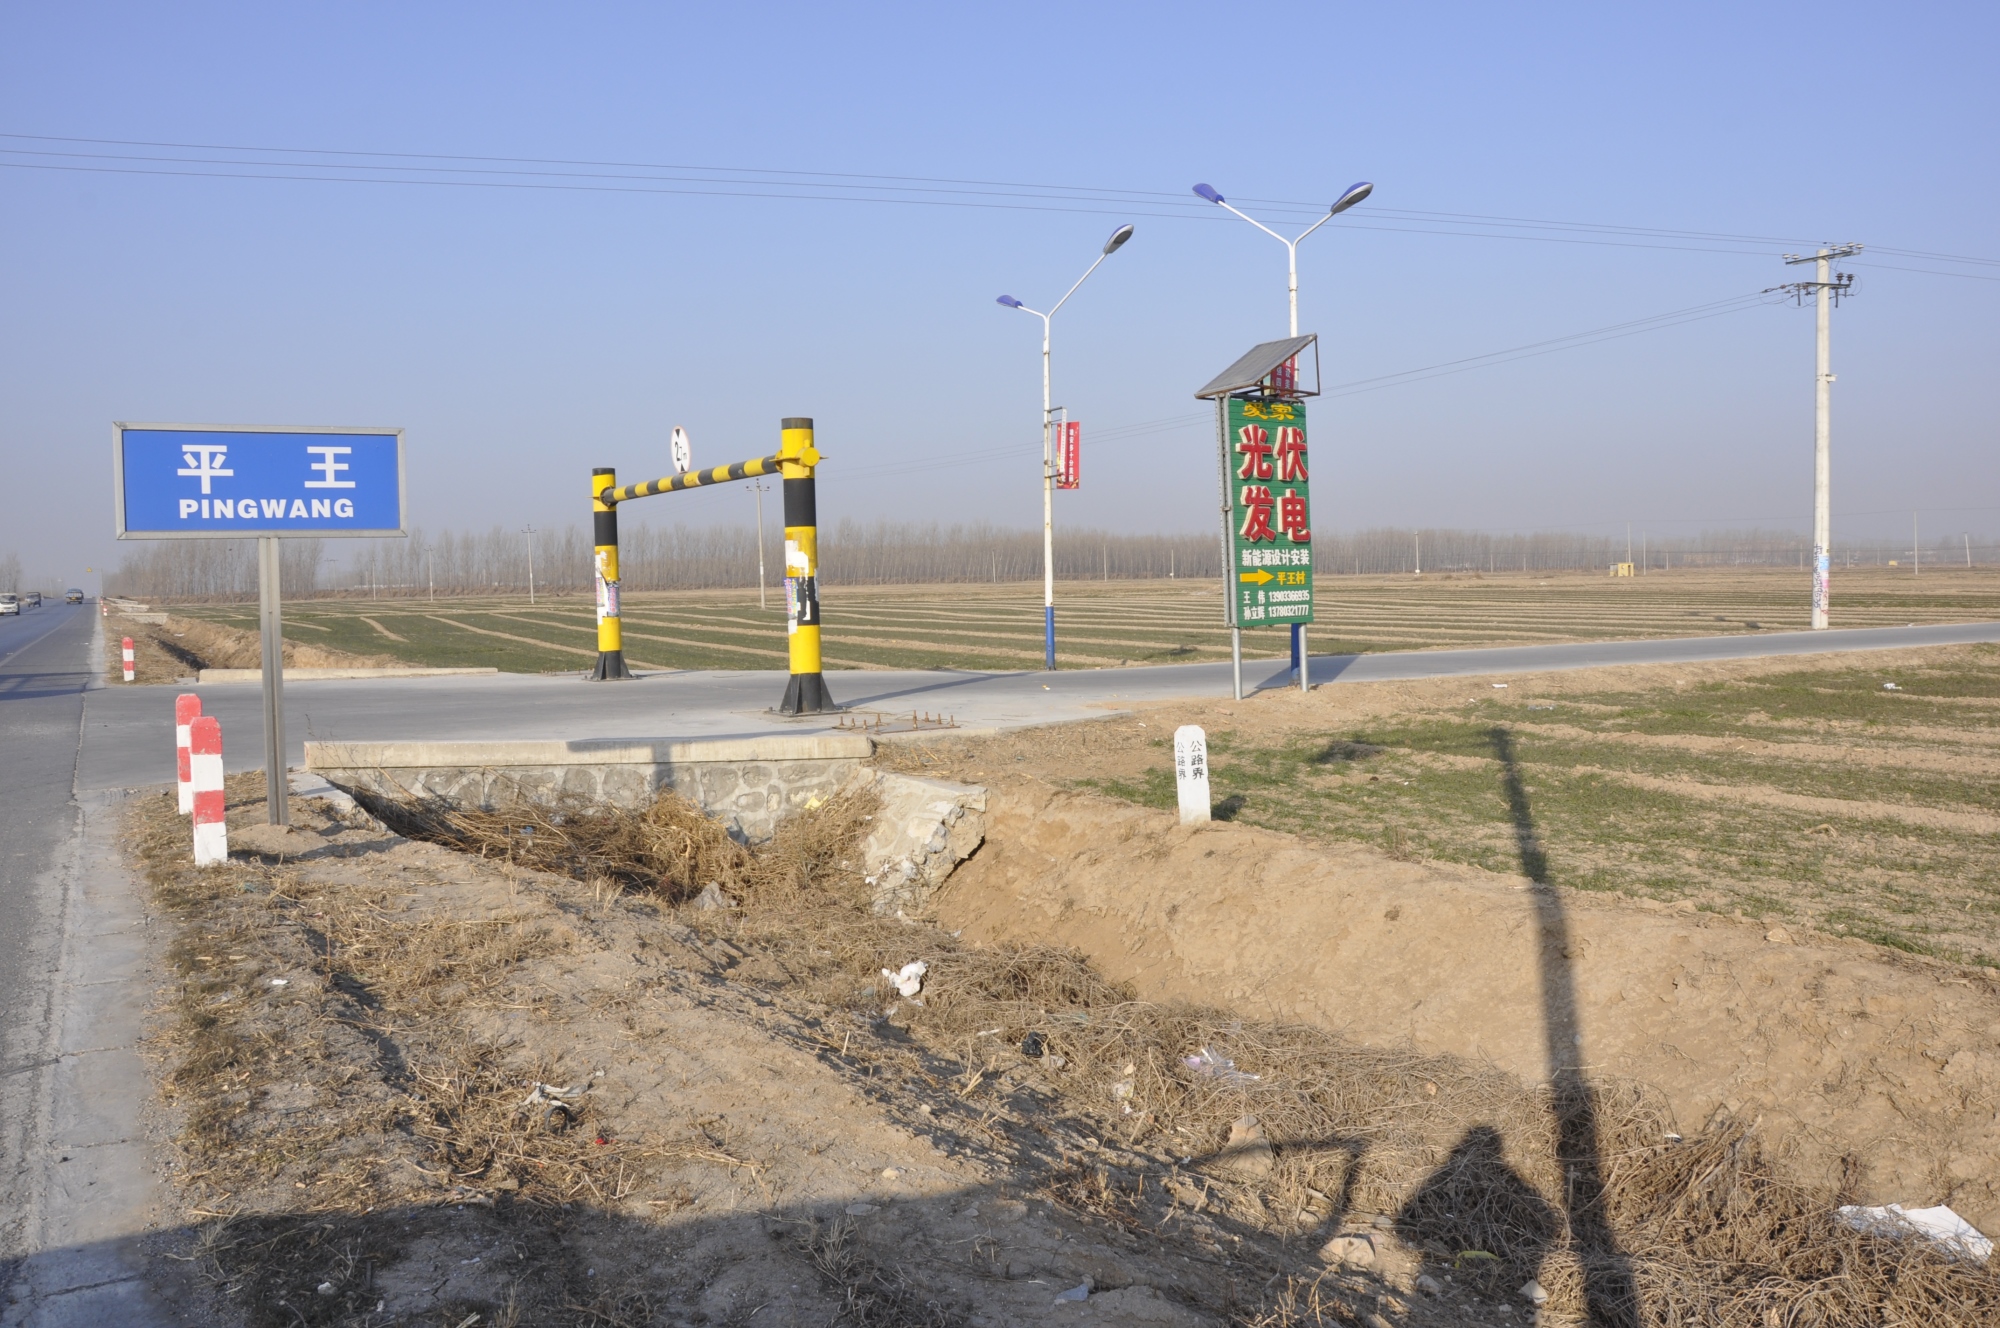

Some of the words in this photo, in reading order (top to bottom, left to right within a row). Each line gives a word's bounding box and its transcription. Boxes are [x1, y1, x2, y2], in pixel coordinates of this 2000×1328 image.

[1235, 424, 1308, 481] 光伏
[179, 498, 354, 519] PINGWANG
[1239, 485, 1311, 542] 发电
[1242, 548, 1310, 566] 新能源设计安装
[1277, 571, 1306, 585] 平王村
[1268, 604, 1309, 617] 13780321777
[1190, 740, 1204, 780] 公路界
